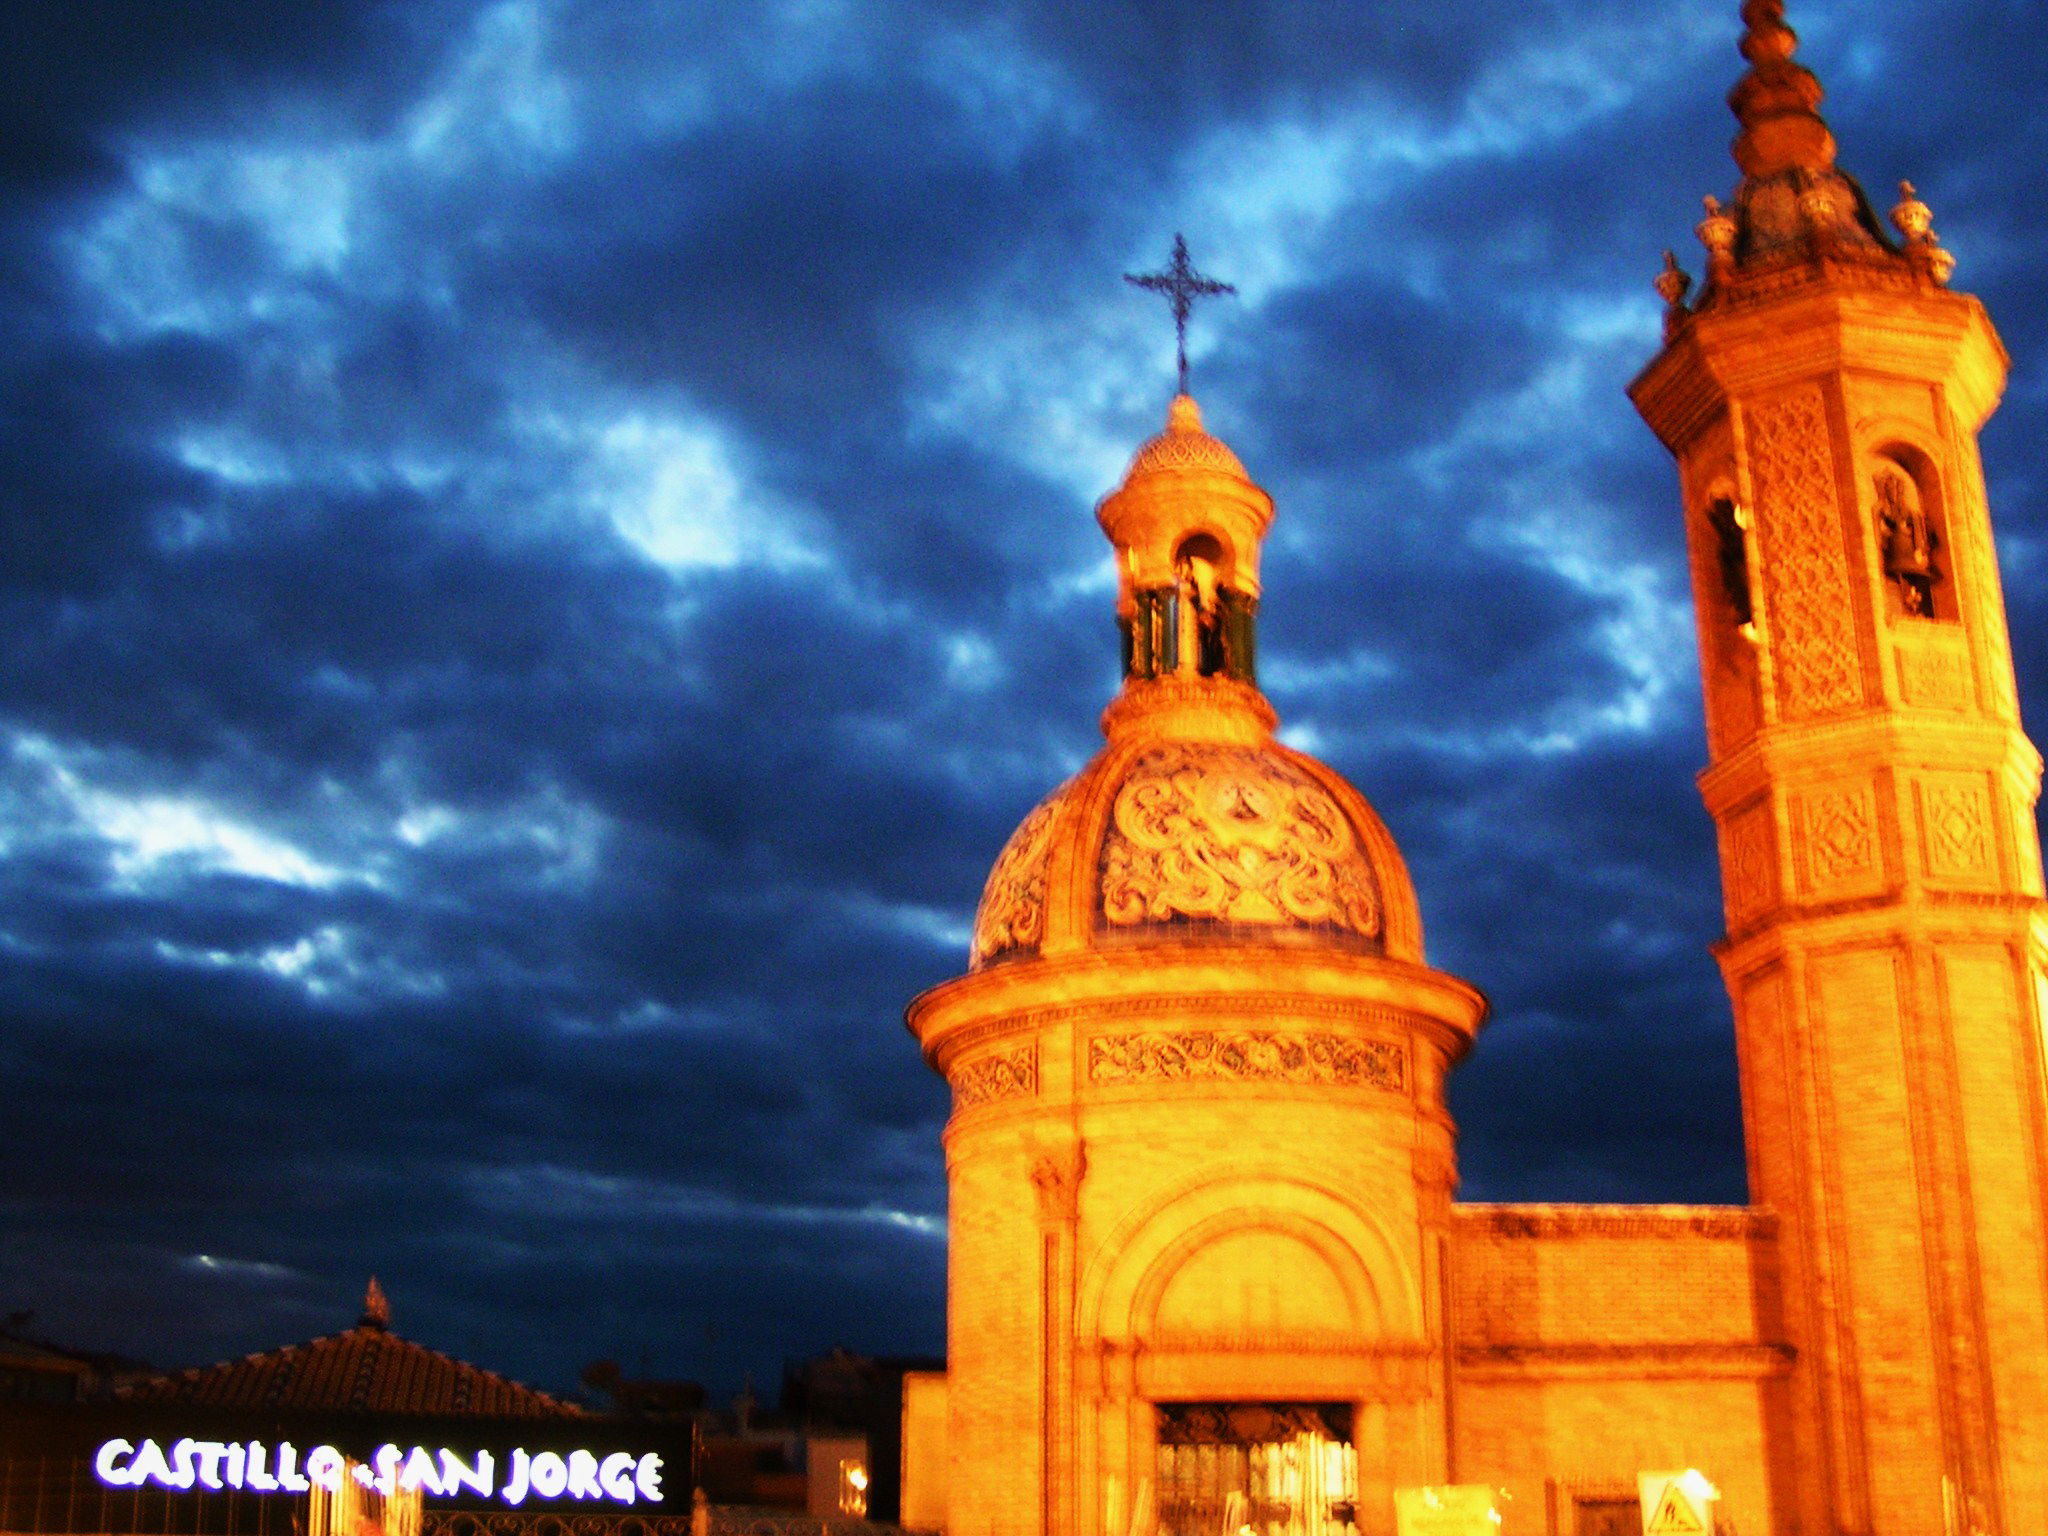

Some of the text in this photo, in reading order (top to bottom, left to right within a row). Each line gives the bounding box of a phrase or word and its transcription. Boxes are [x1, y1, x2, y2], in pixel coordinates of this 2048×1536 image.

[96, 1438, 346, 1492] CASTILLO
[374, 1443, 495, 1498] SAN
[502, 1447, 665, 1505] JORGE
